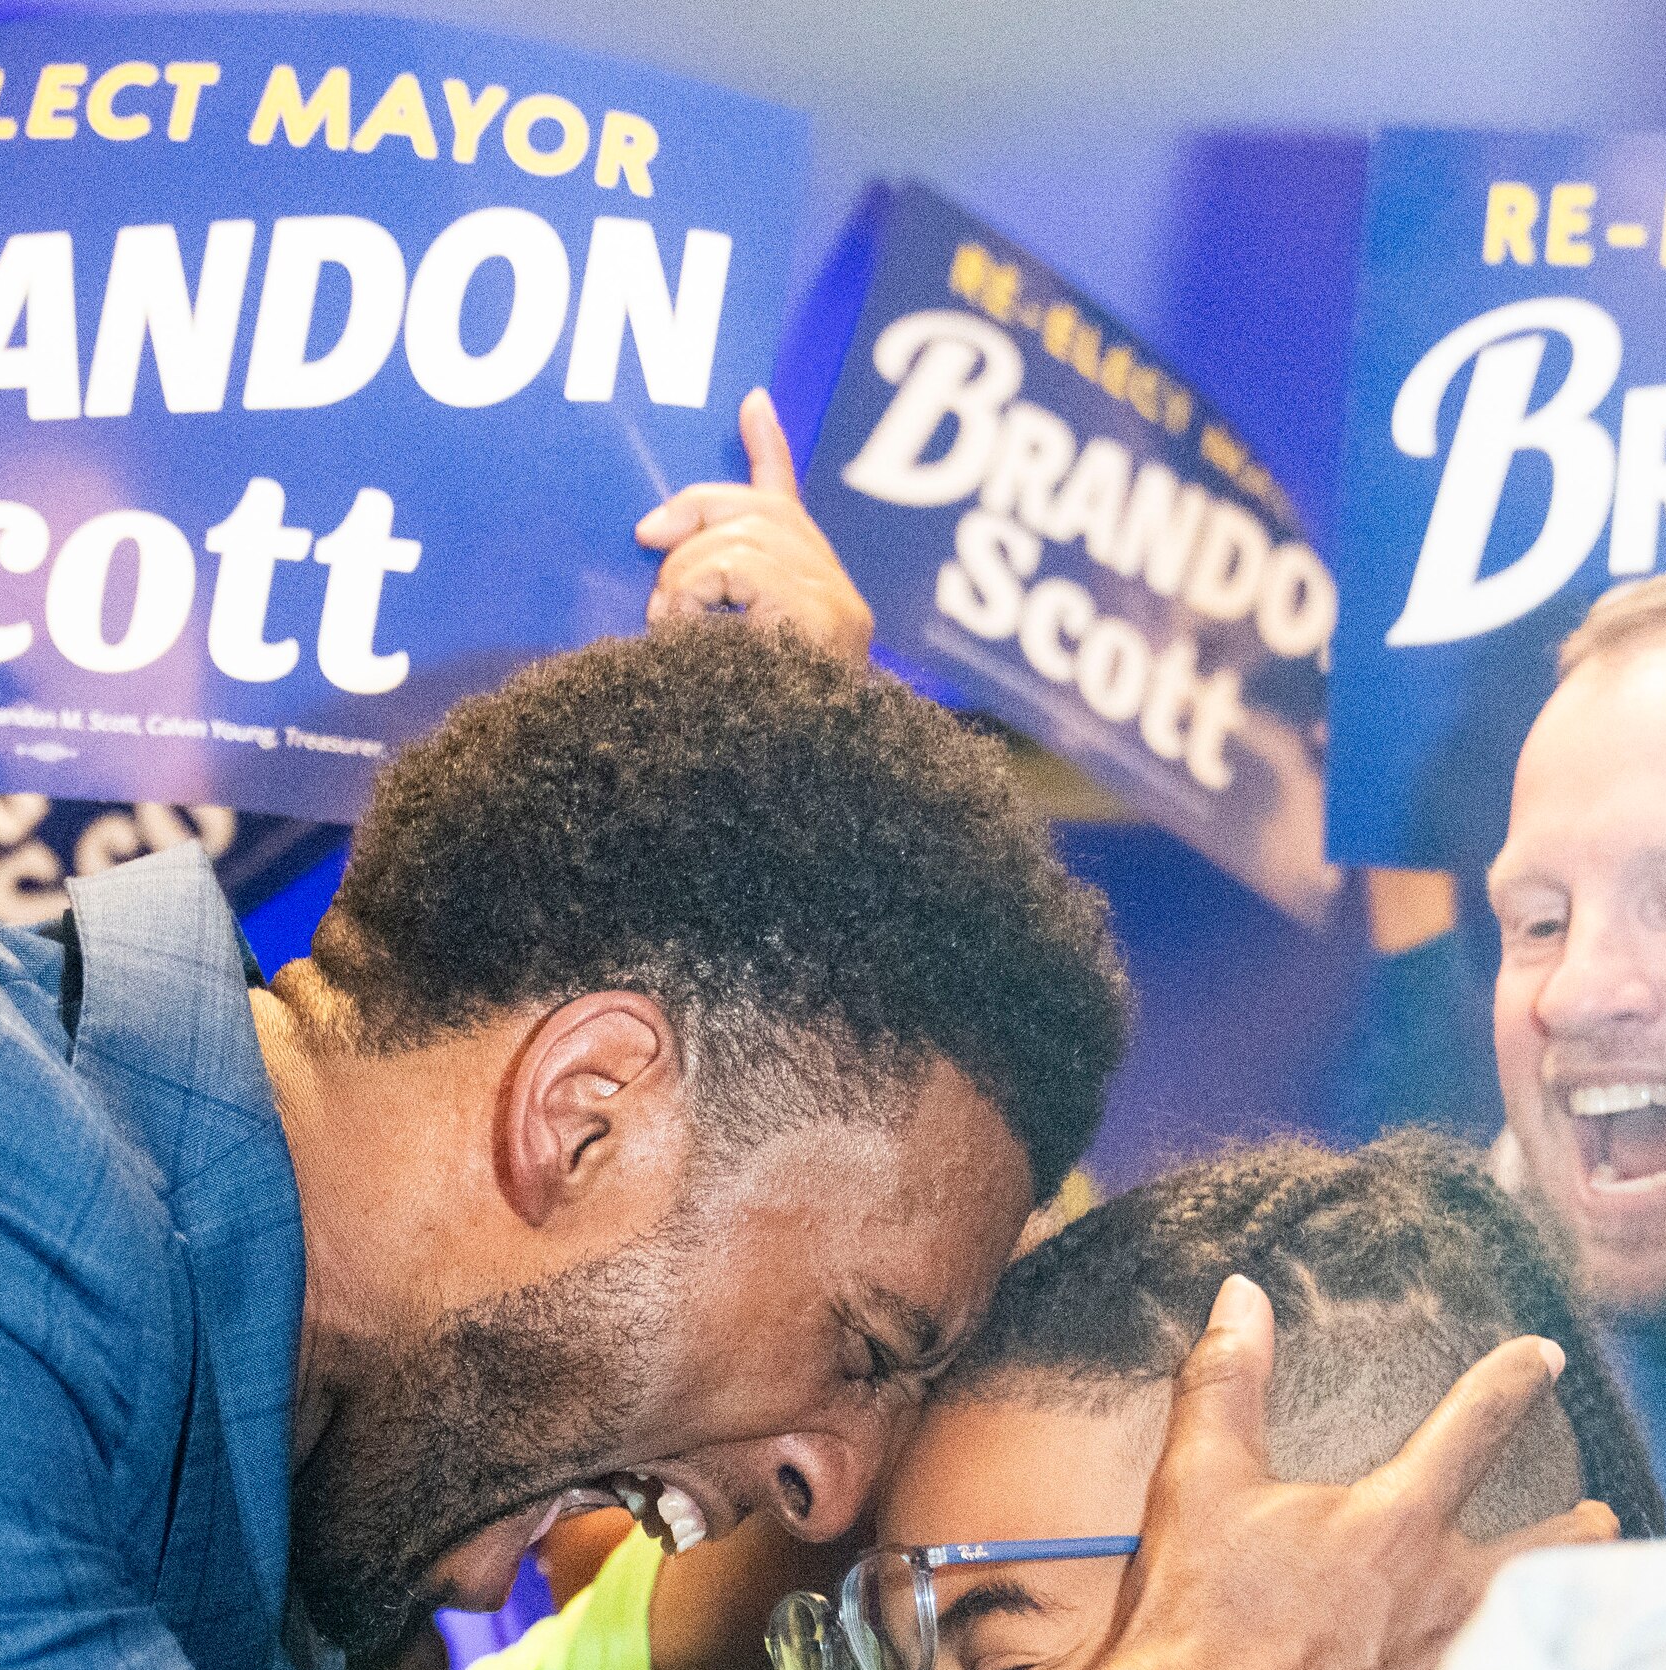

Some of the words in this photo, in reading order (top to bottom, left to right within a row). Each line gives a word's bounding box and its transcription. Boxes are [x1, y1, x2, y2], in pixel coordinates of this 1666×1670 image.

[247, 63, 661, 199] MAYOR
[839, 307, 1339, 674] BRANDO
[935, 502, 1245, 793] Scott
